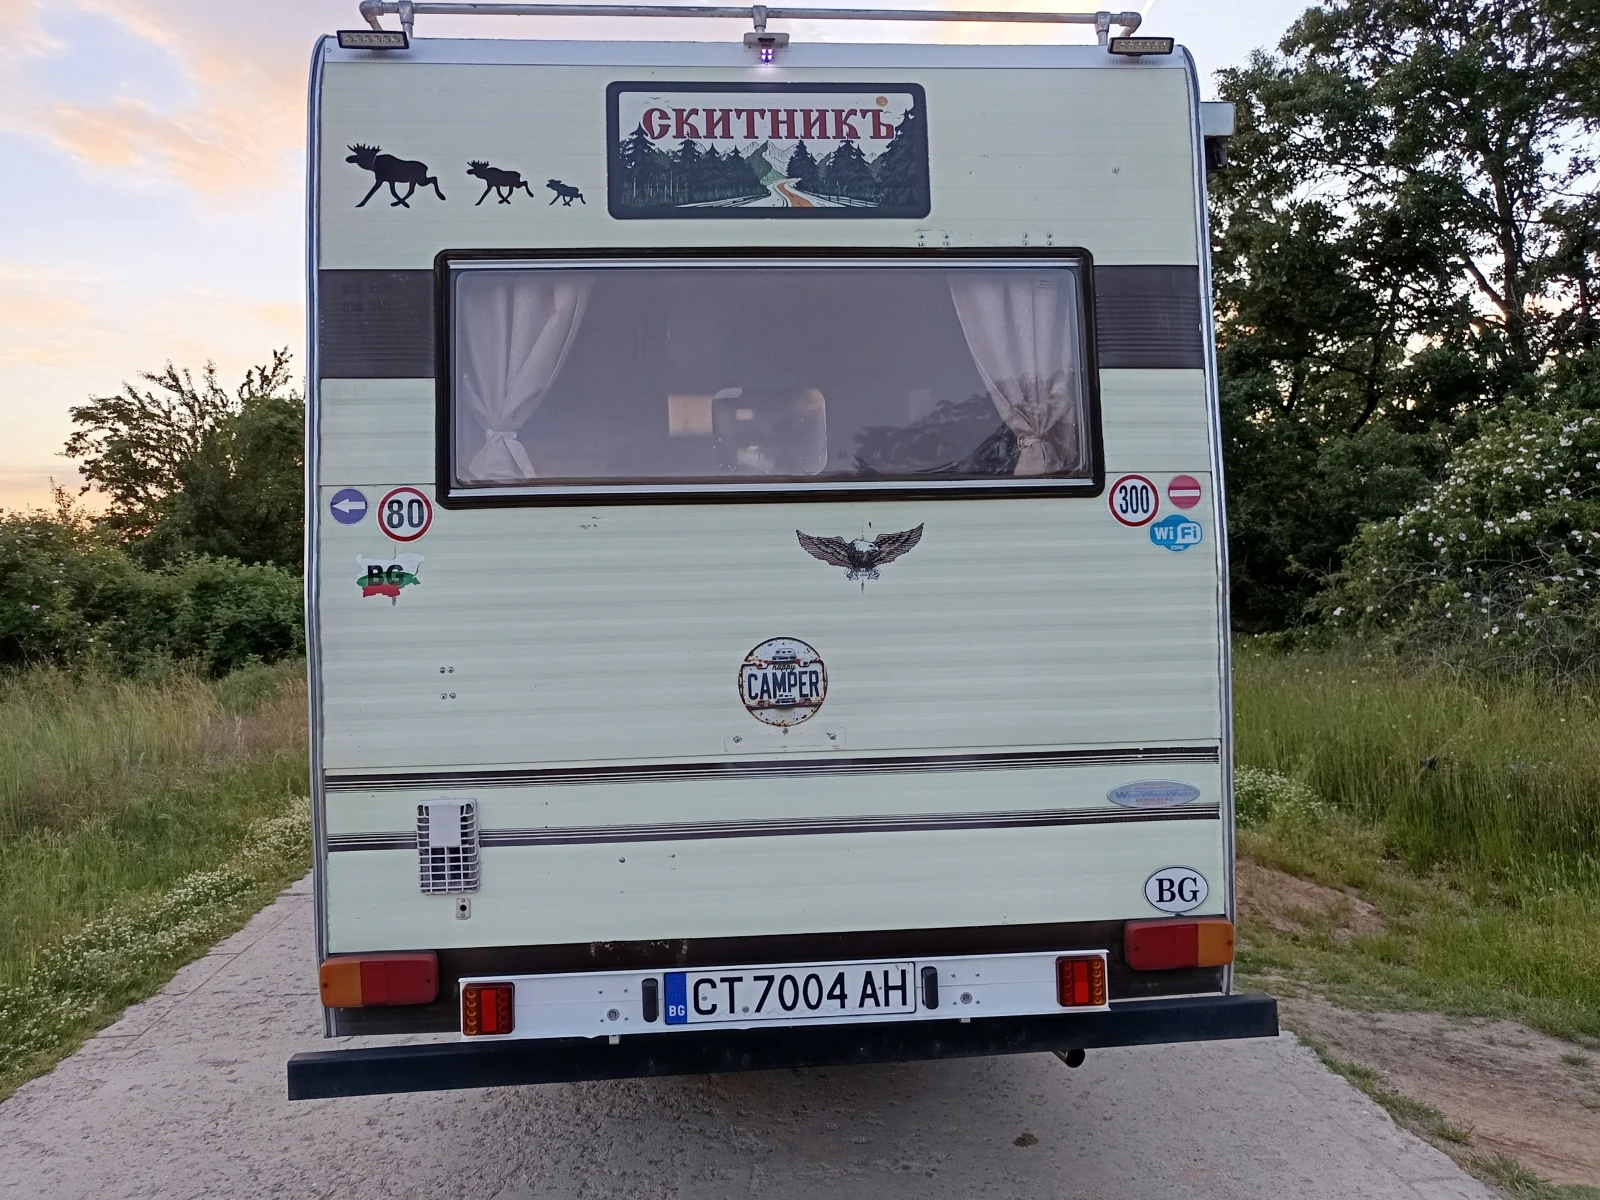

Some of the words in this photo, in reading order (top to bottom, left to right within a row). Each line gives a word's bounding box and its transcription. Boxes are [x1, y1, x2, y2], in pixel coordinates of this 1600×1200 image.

[642, 107, 895, 139] СКИТНИКЪ
[387, 498, 425, 529] 80
[1119, 485, 1150, 514] 300
[367, 564, 405, 587] BG
[772, 664, 797, 672] happy
[747, 670, 820, 700] CAMPER
[1155, 876, 1200, 903] BG
[693, 976, 744, 1015] CT
[753, 971, 848, 1013] 7004
[858, 969, 907, 1008] AH
[668, 1005, 686, 1016] BG
